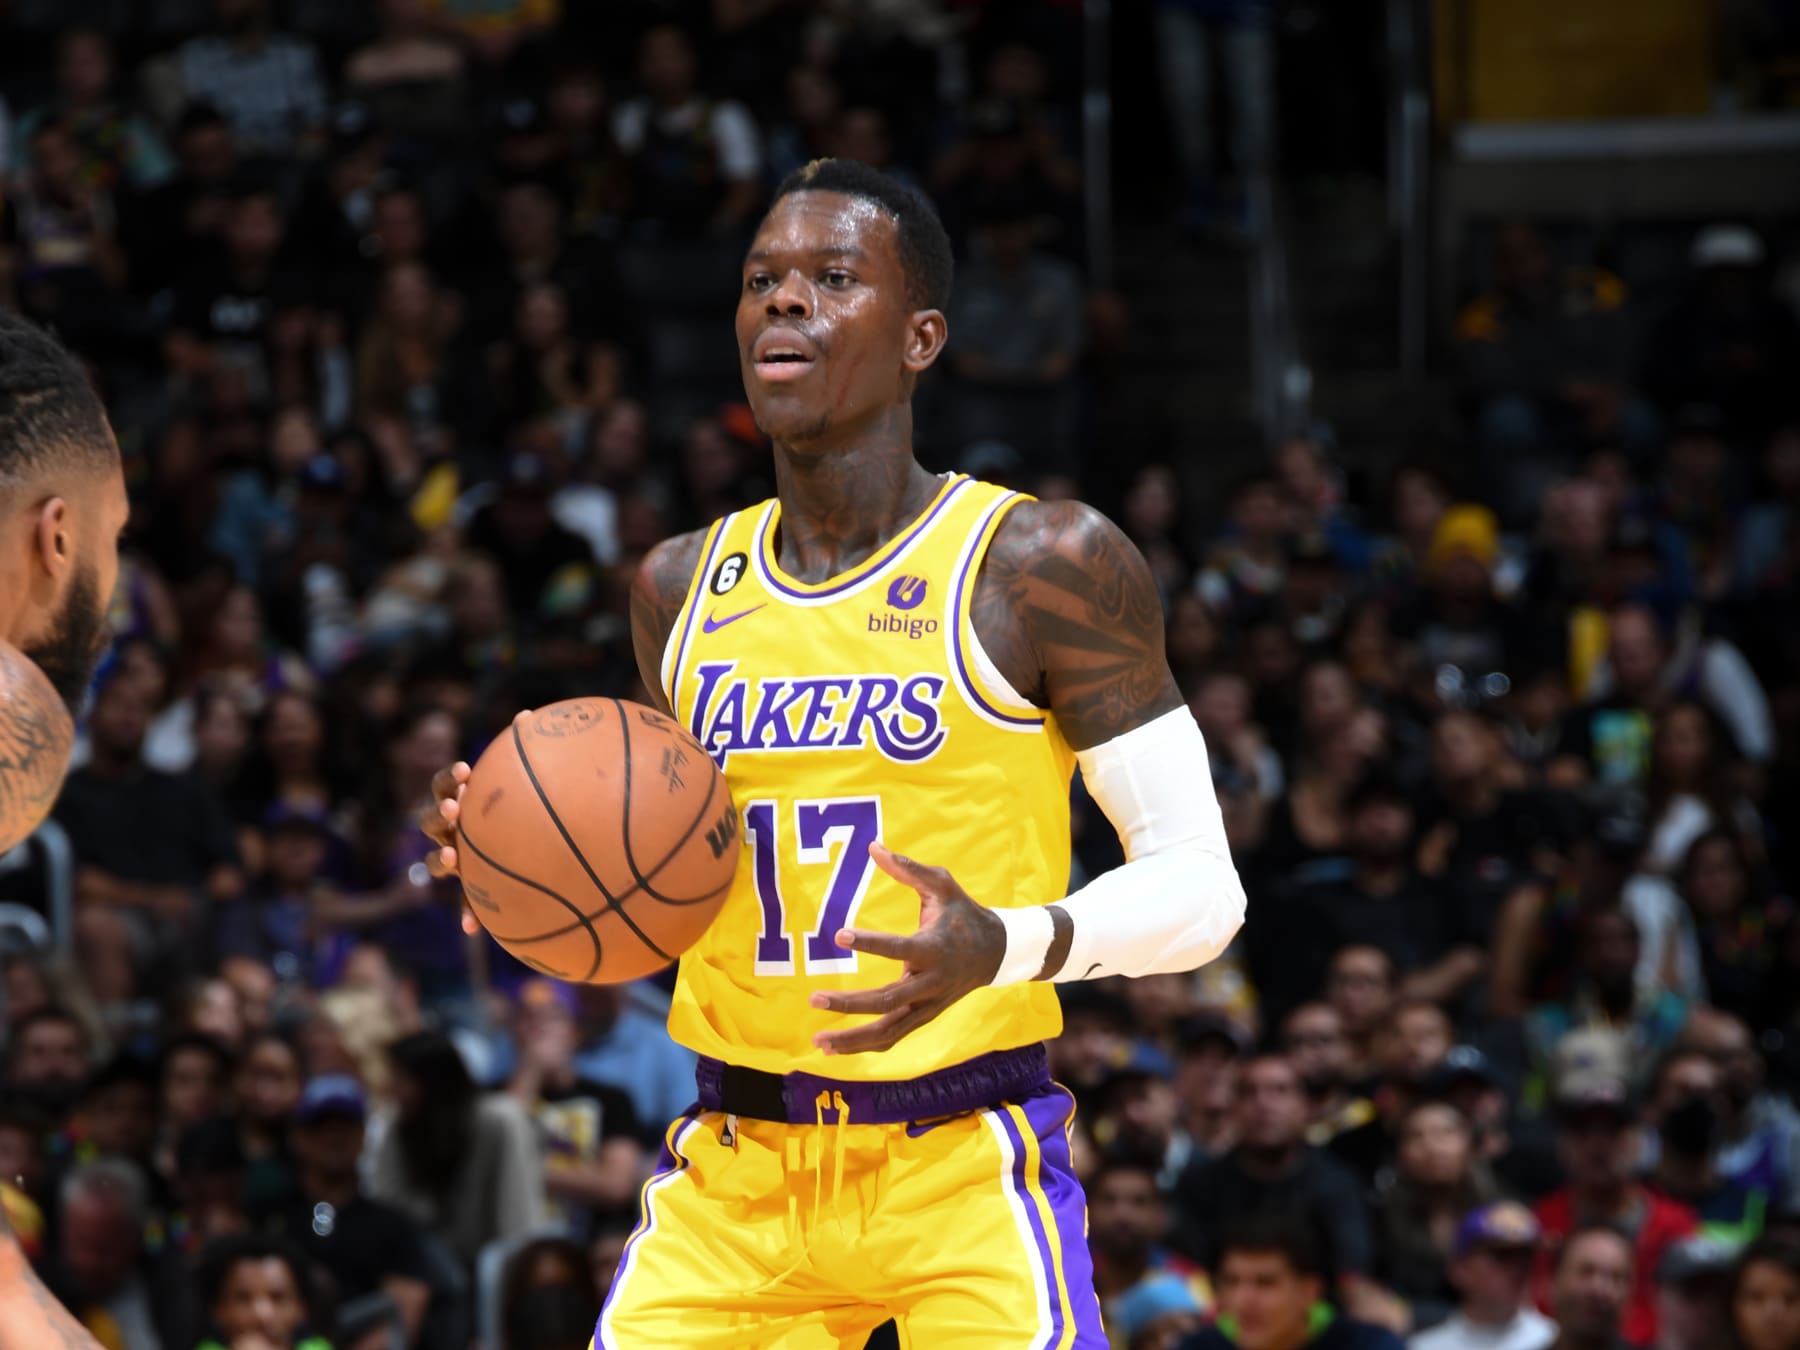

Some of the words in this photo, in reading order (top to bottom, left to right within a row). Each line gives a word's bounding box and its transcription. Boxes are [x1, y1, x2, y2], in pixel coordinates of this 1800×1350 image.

[715, 556, 742, 594] 6
[868, 612, 938, 639] bibigo
[690, 660, 946, 772] LAKERS
[746, 798, 882, 976] 17
